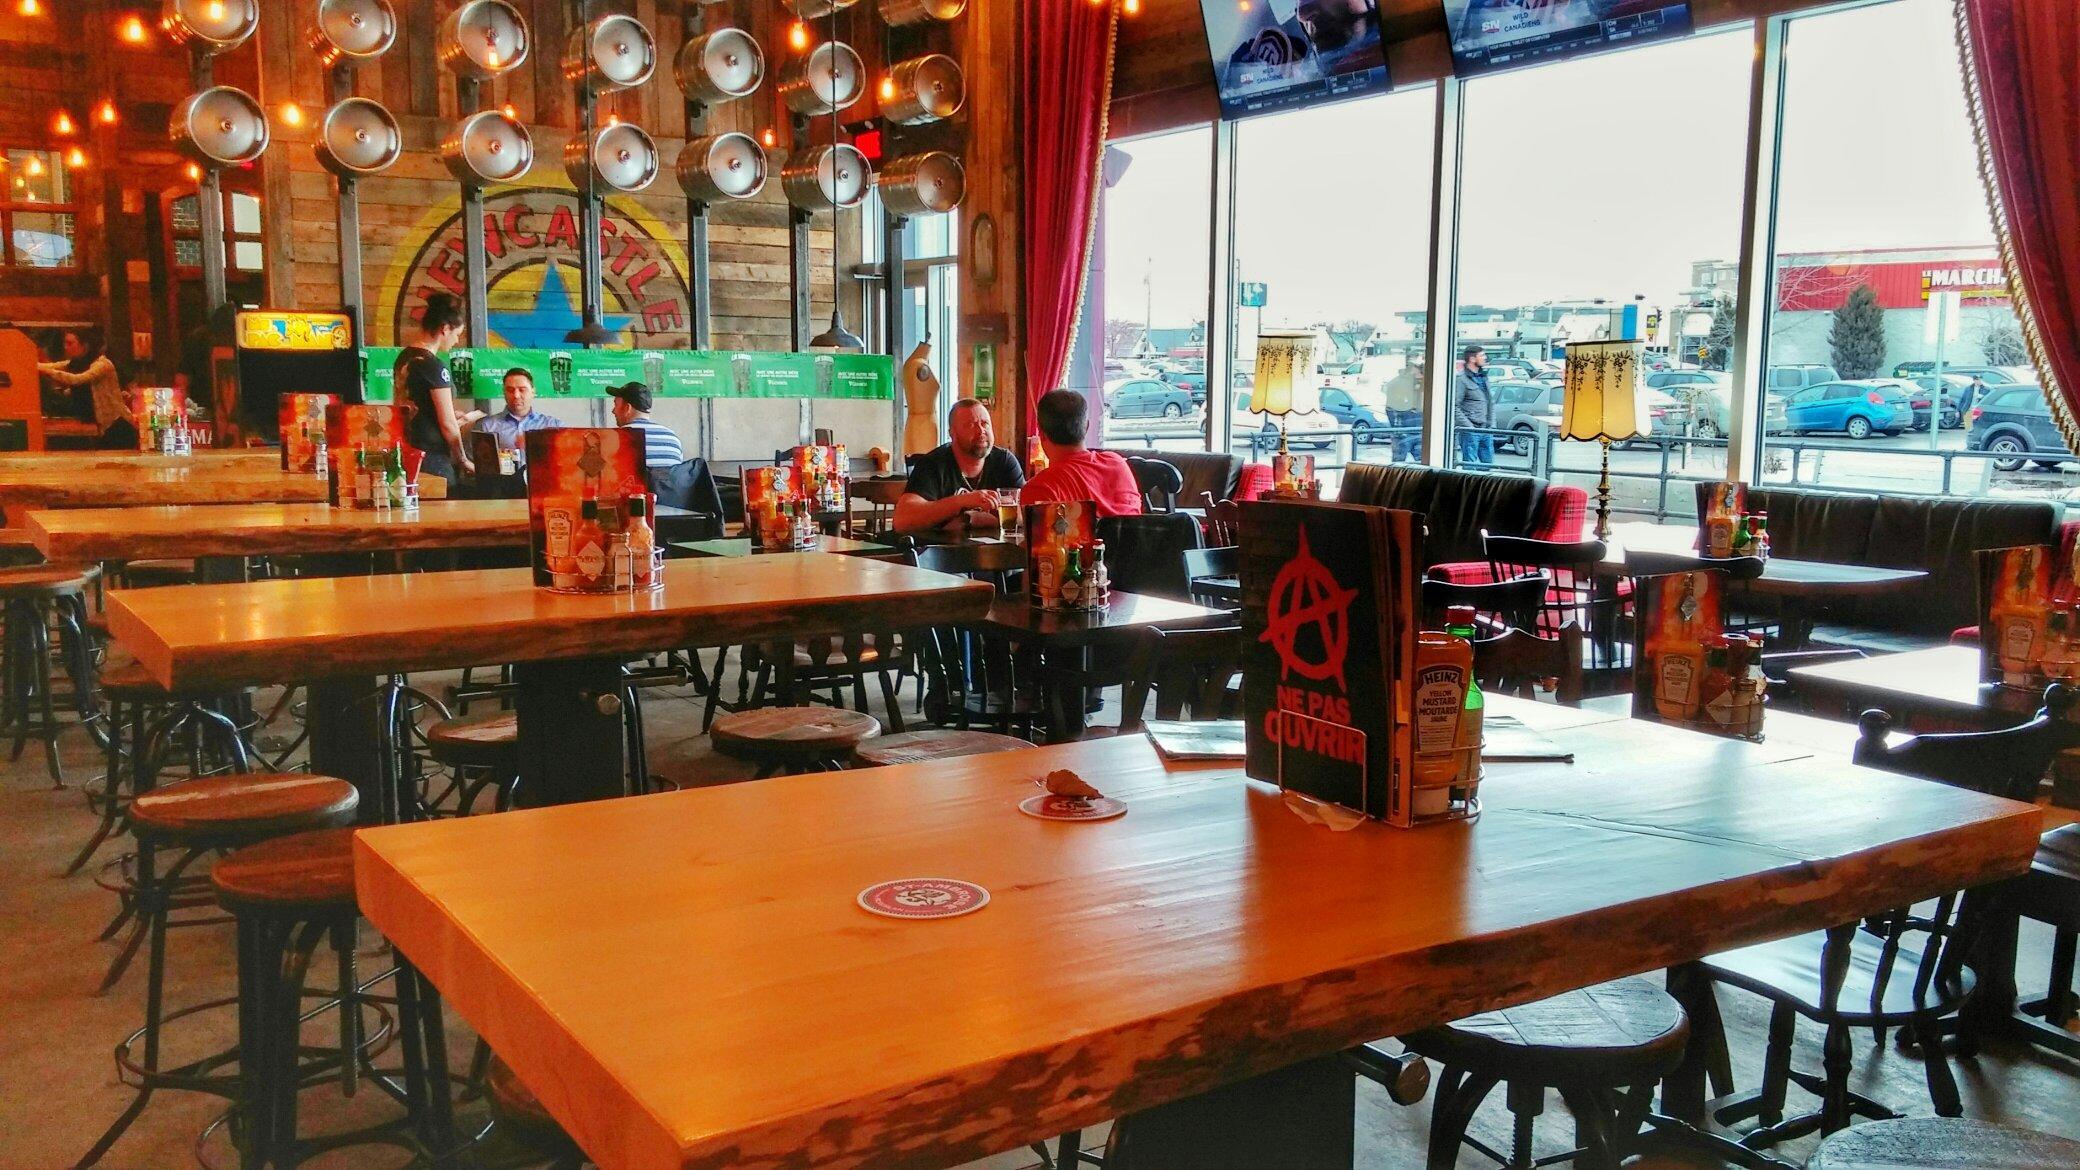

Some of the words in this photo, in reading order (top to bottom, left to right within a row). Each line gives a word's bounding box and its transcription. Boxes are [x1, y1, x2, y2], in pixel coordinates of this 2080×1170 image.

[1504, 19, 1541, 32] CANADIENS
[1424, 671, 1458, 685] HEINZ
[1429, 689, 1453, 698] YELLOW
[1276, 684, 1305, 712] NE
[1308, 691, 1351, 724] PAS
[1422, 697, 1457, 706] MUSTARD
[1419, 705, 1459, 716] MOUTARDE
[1264, 710, 1366, 764] OUVRIR
